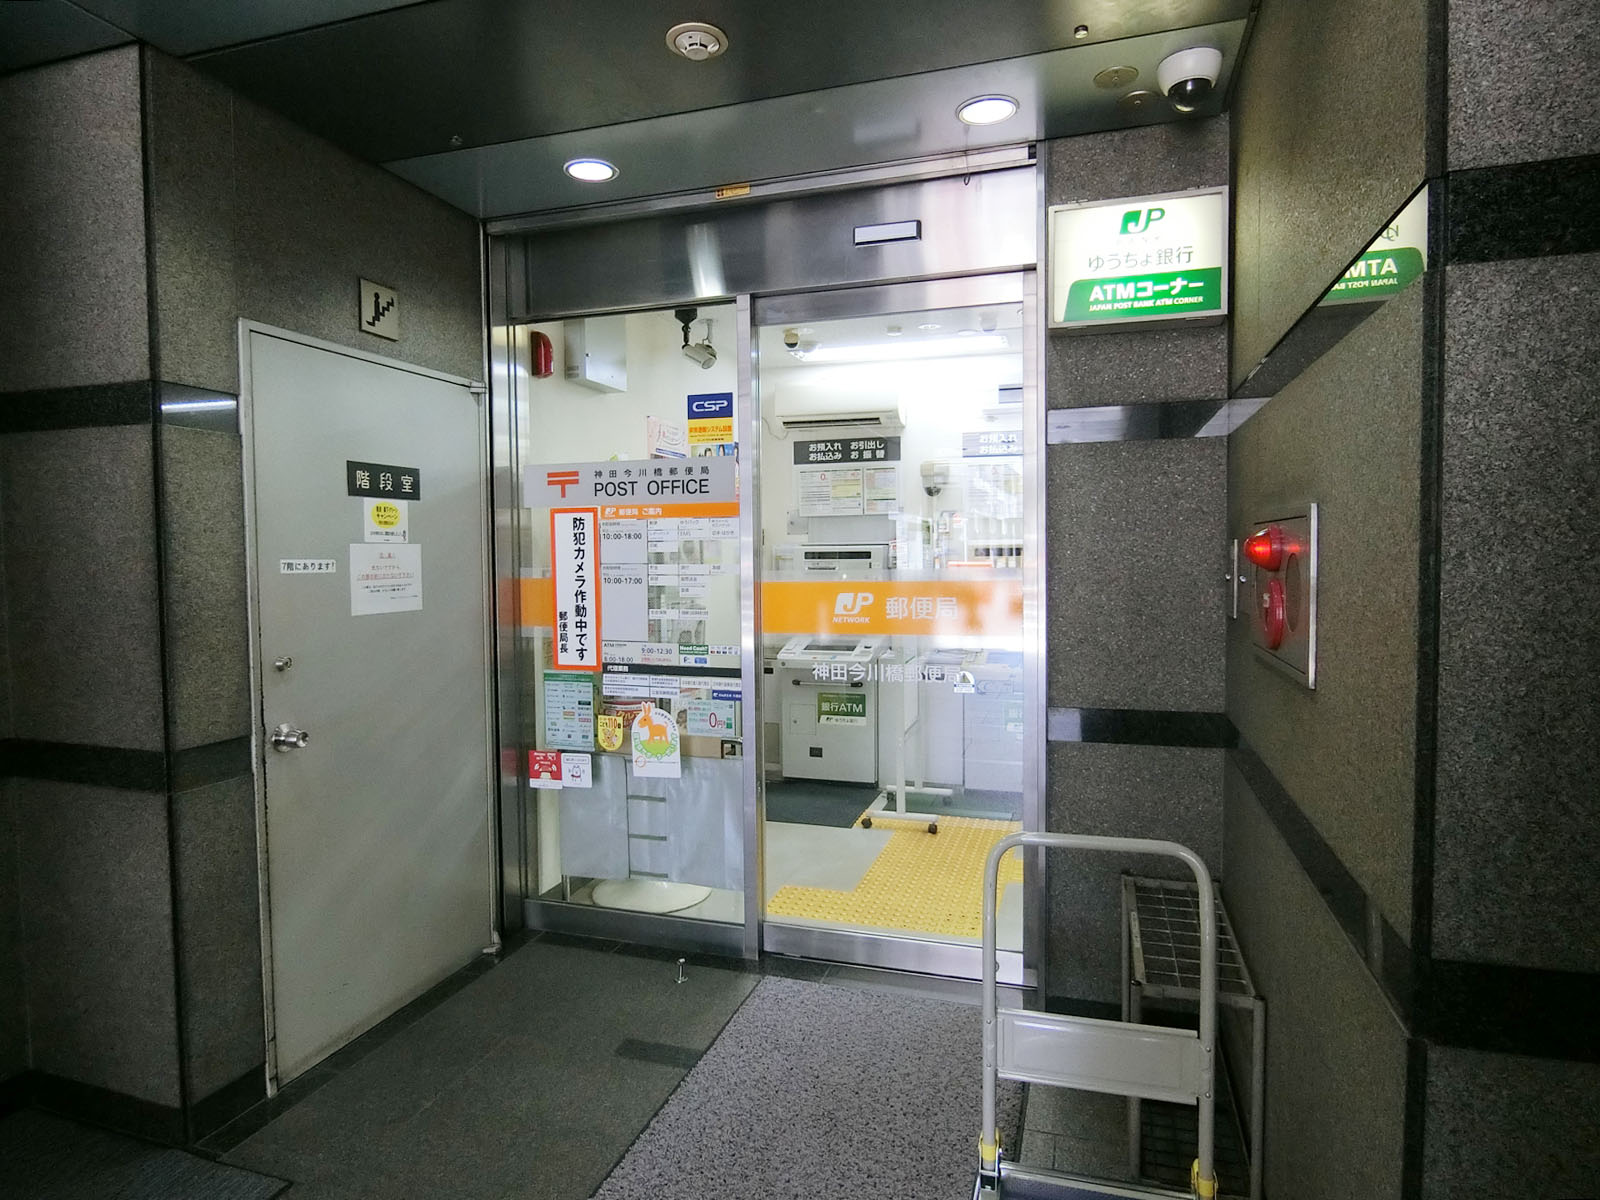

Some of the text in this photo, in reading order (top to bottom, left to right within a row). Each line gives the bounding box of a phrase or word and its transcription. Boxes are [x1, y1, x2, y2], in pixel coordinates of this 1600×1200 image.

[1088, 245, 1195, 273] ゆうちょ銀行
[1088, 277, 1204, 302] ATMコーナー
[1088, 295, 1204, 312] JAPAN POST BANK ATM CORNER
[692, 400, 728, 412] CSP
[808, 439, 885, 453] お預入れ お引出し
[808, 449, 886, 462] お払込み お振替
[594, 465, 710, 479] 神田今川橋郵便局
[355, 470, 414, 493] 階段室
[594, 479, 710, 498] POST OFFICE
[602, 532, 642, 541] 10:00-18:00
[603, 576, 643, 585] 10:00-17:00
[572, 517, 588, 662] 防犯カメラ作動中です
[885, 595, 958, 621] 郵便局
[832, 616, 871, 624] NETWORK
[558, 610, 569, 655] 郵便局長
[641, 647, 673, 656] 9:00-12:30
[812, 661, 962, 684] 神田今川橋郵便局
[821, 701, 863, 713] 銀行ATM
